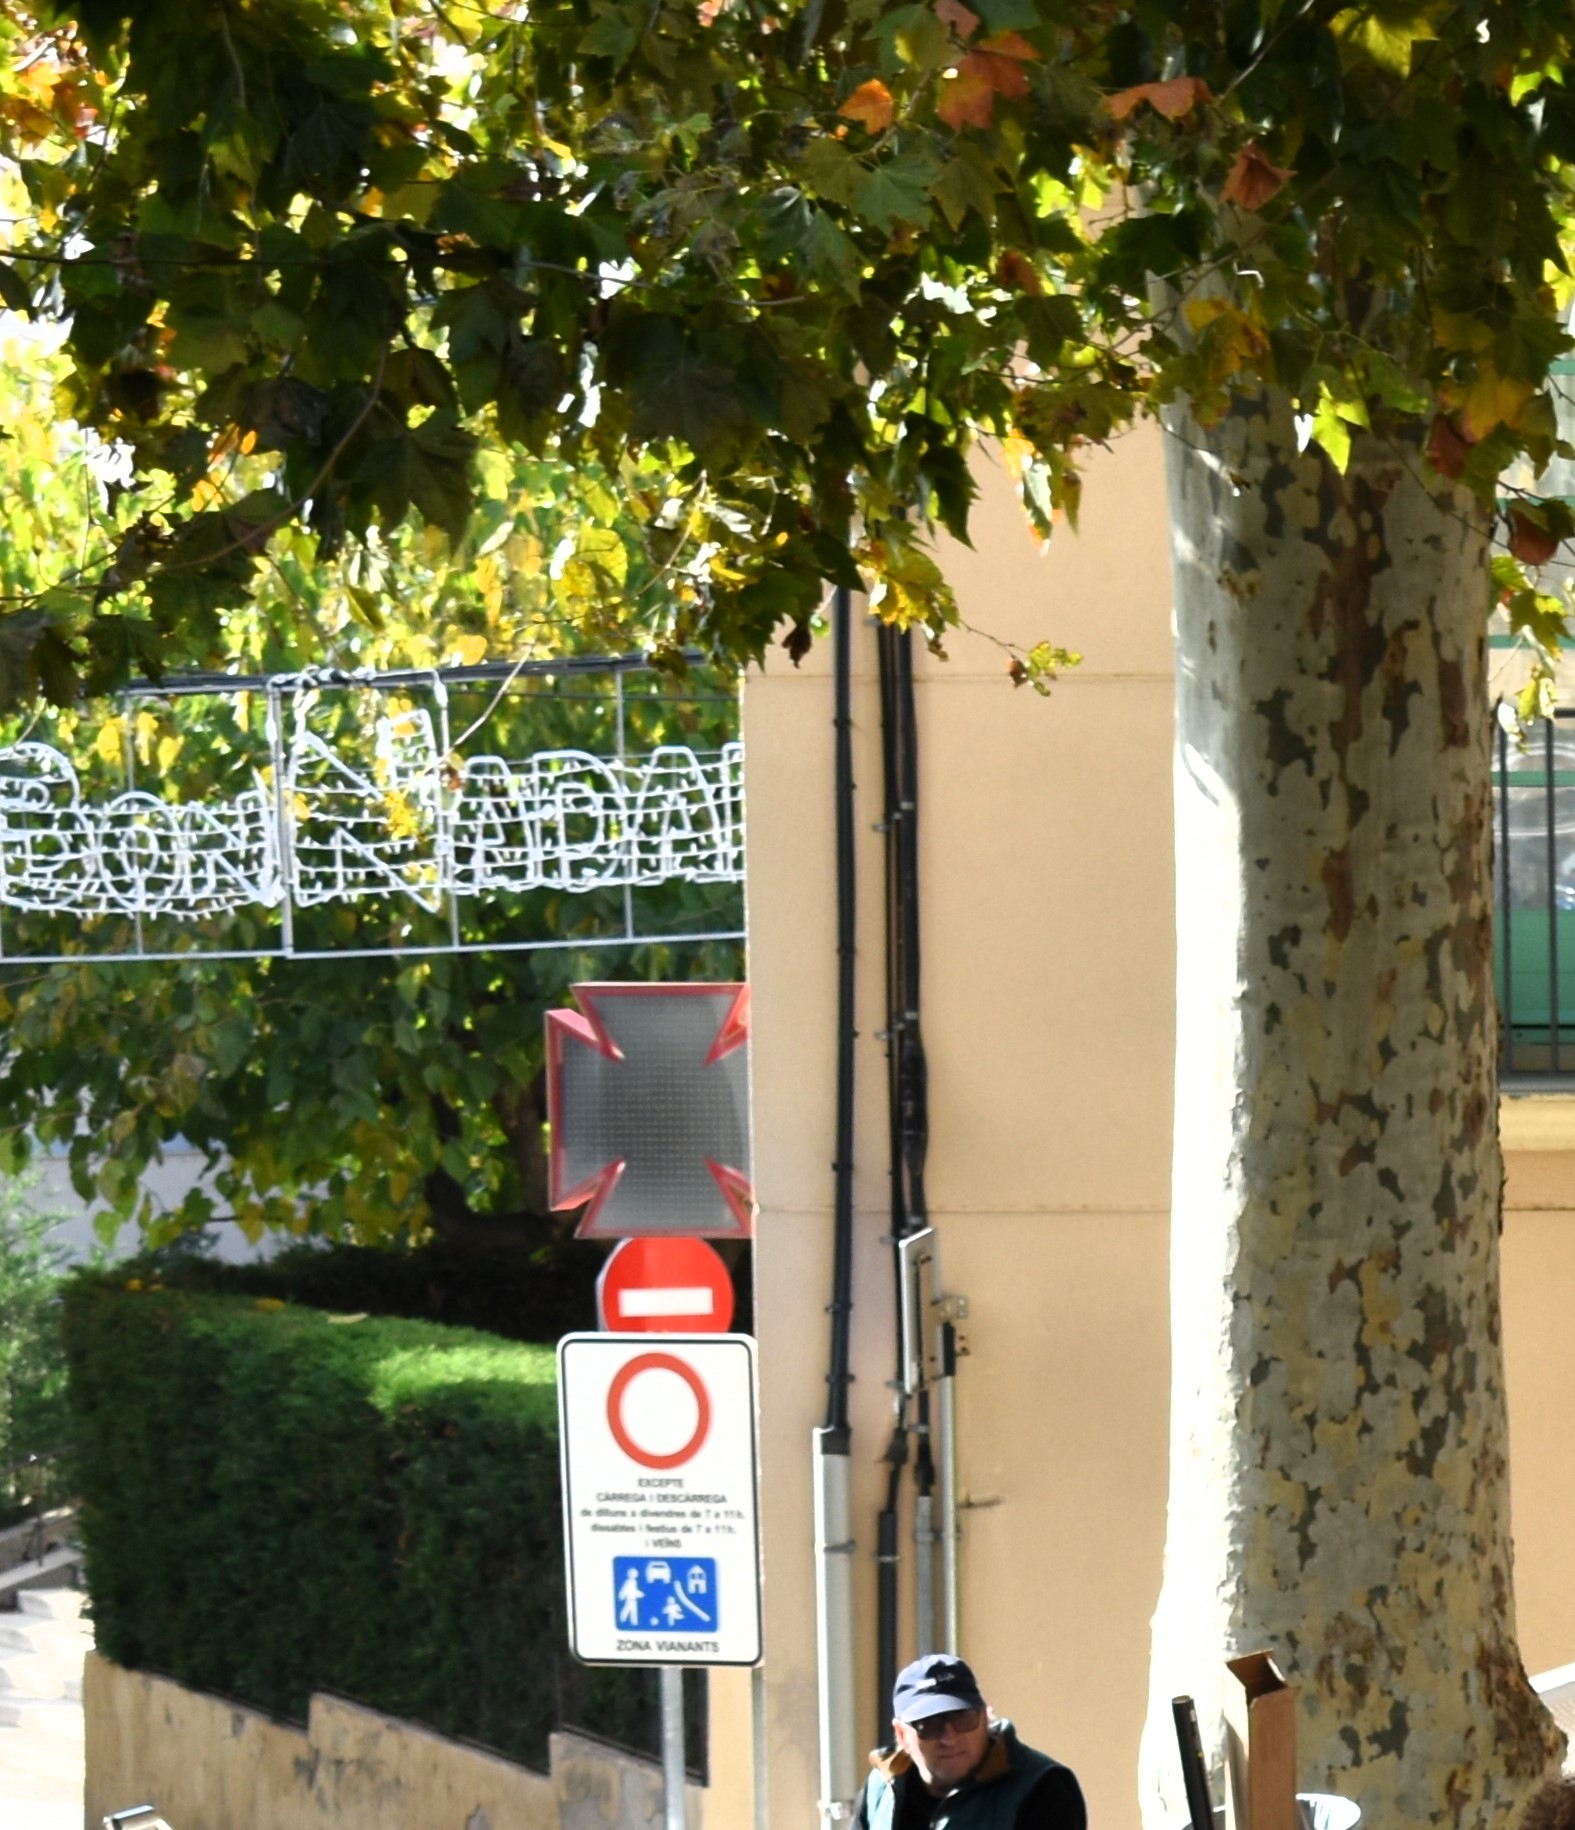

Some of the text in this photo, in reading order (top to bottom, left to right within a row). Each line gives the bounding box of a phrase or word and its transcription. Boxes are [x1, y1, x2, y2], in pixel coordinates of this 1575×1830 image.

[638, 1478, 685, 1488] EXCEPTE
[616, 1639, 720, 1653] ZONA VIANANTS
